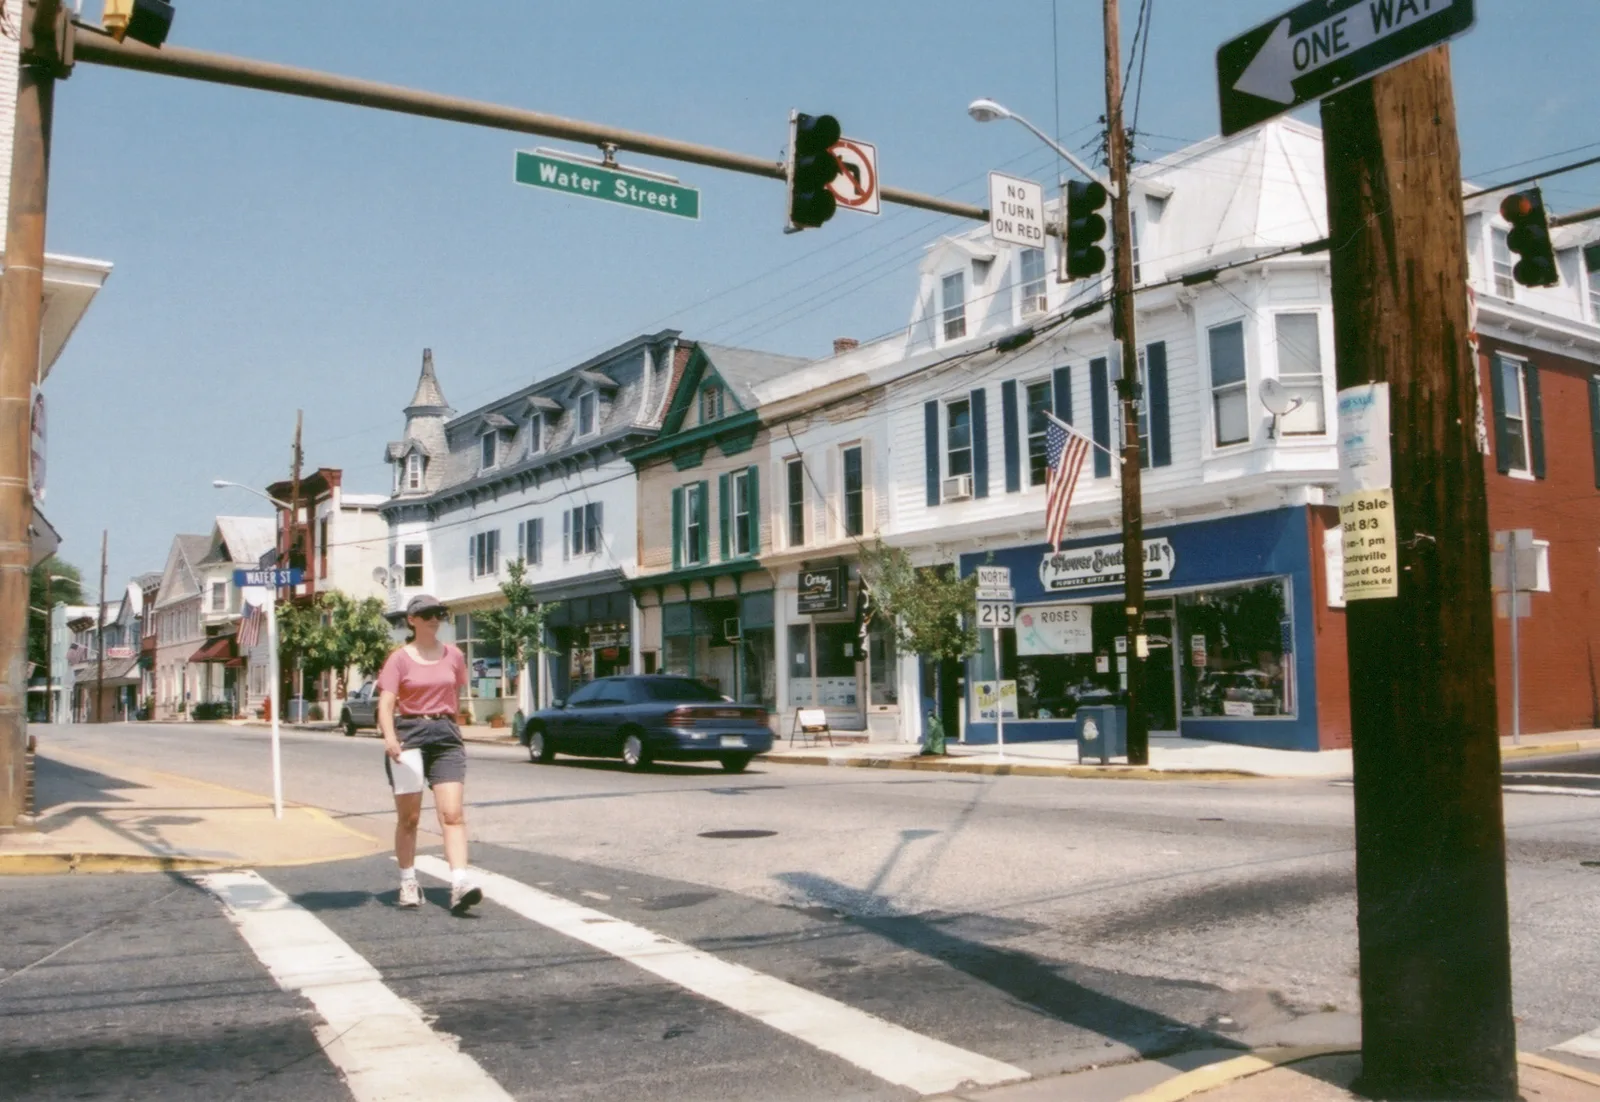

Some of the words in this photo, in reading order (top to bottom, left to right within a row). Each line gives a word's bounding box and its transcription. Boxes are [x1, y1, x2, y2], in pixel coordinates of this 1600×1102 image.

[1292, 17, 1350, 71] ONE
[1369, 0, 1431, 35] WA
[538, 163, 601, 193] Water
[614, 179, 678, 209] Street
[1007, 184, 1026, 200] NO
[1000, 201, 1034, 220] TURN
[996, 218, 1013, 234] ON
[1017, 223, 1041, 240] RED
[1358, 518, 1379, 530] 8/3
[1368, 537, 1386, 547] pm
[1050, 554, 1092, 576] Flower
[1361, 567, 1369, 575] of
[1371, 565, 1391, 574] God
[245, 570, 277, 585] WATER
[280, 570, 292, 584] ST
[981, 571, 1009, 583] NORTH
[982, 604, 1011, 623] 213
[1040, 610, 1078, 623] ROSES
